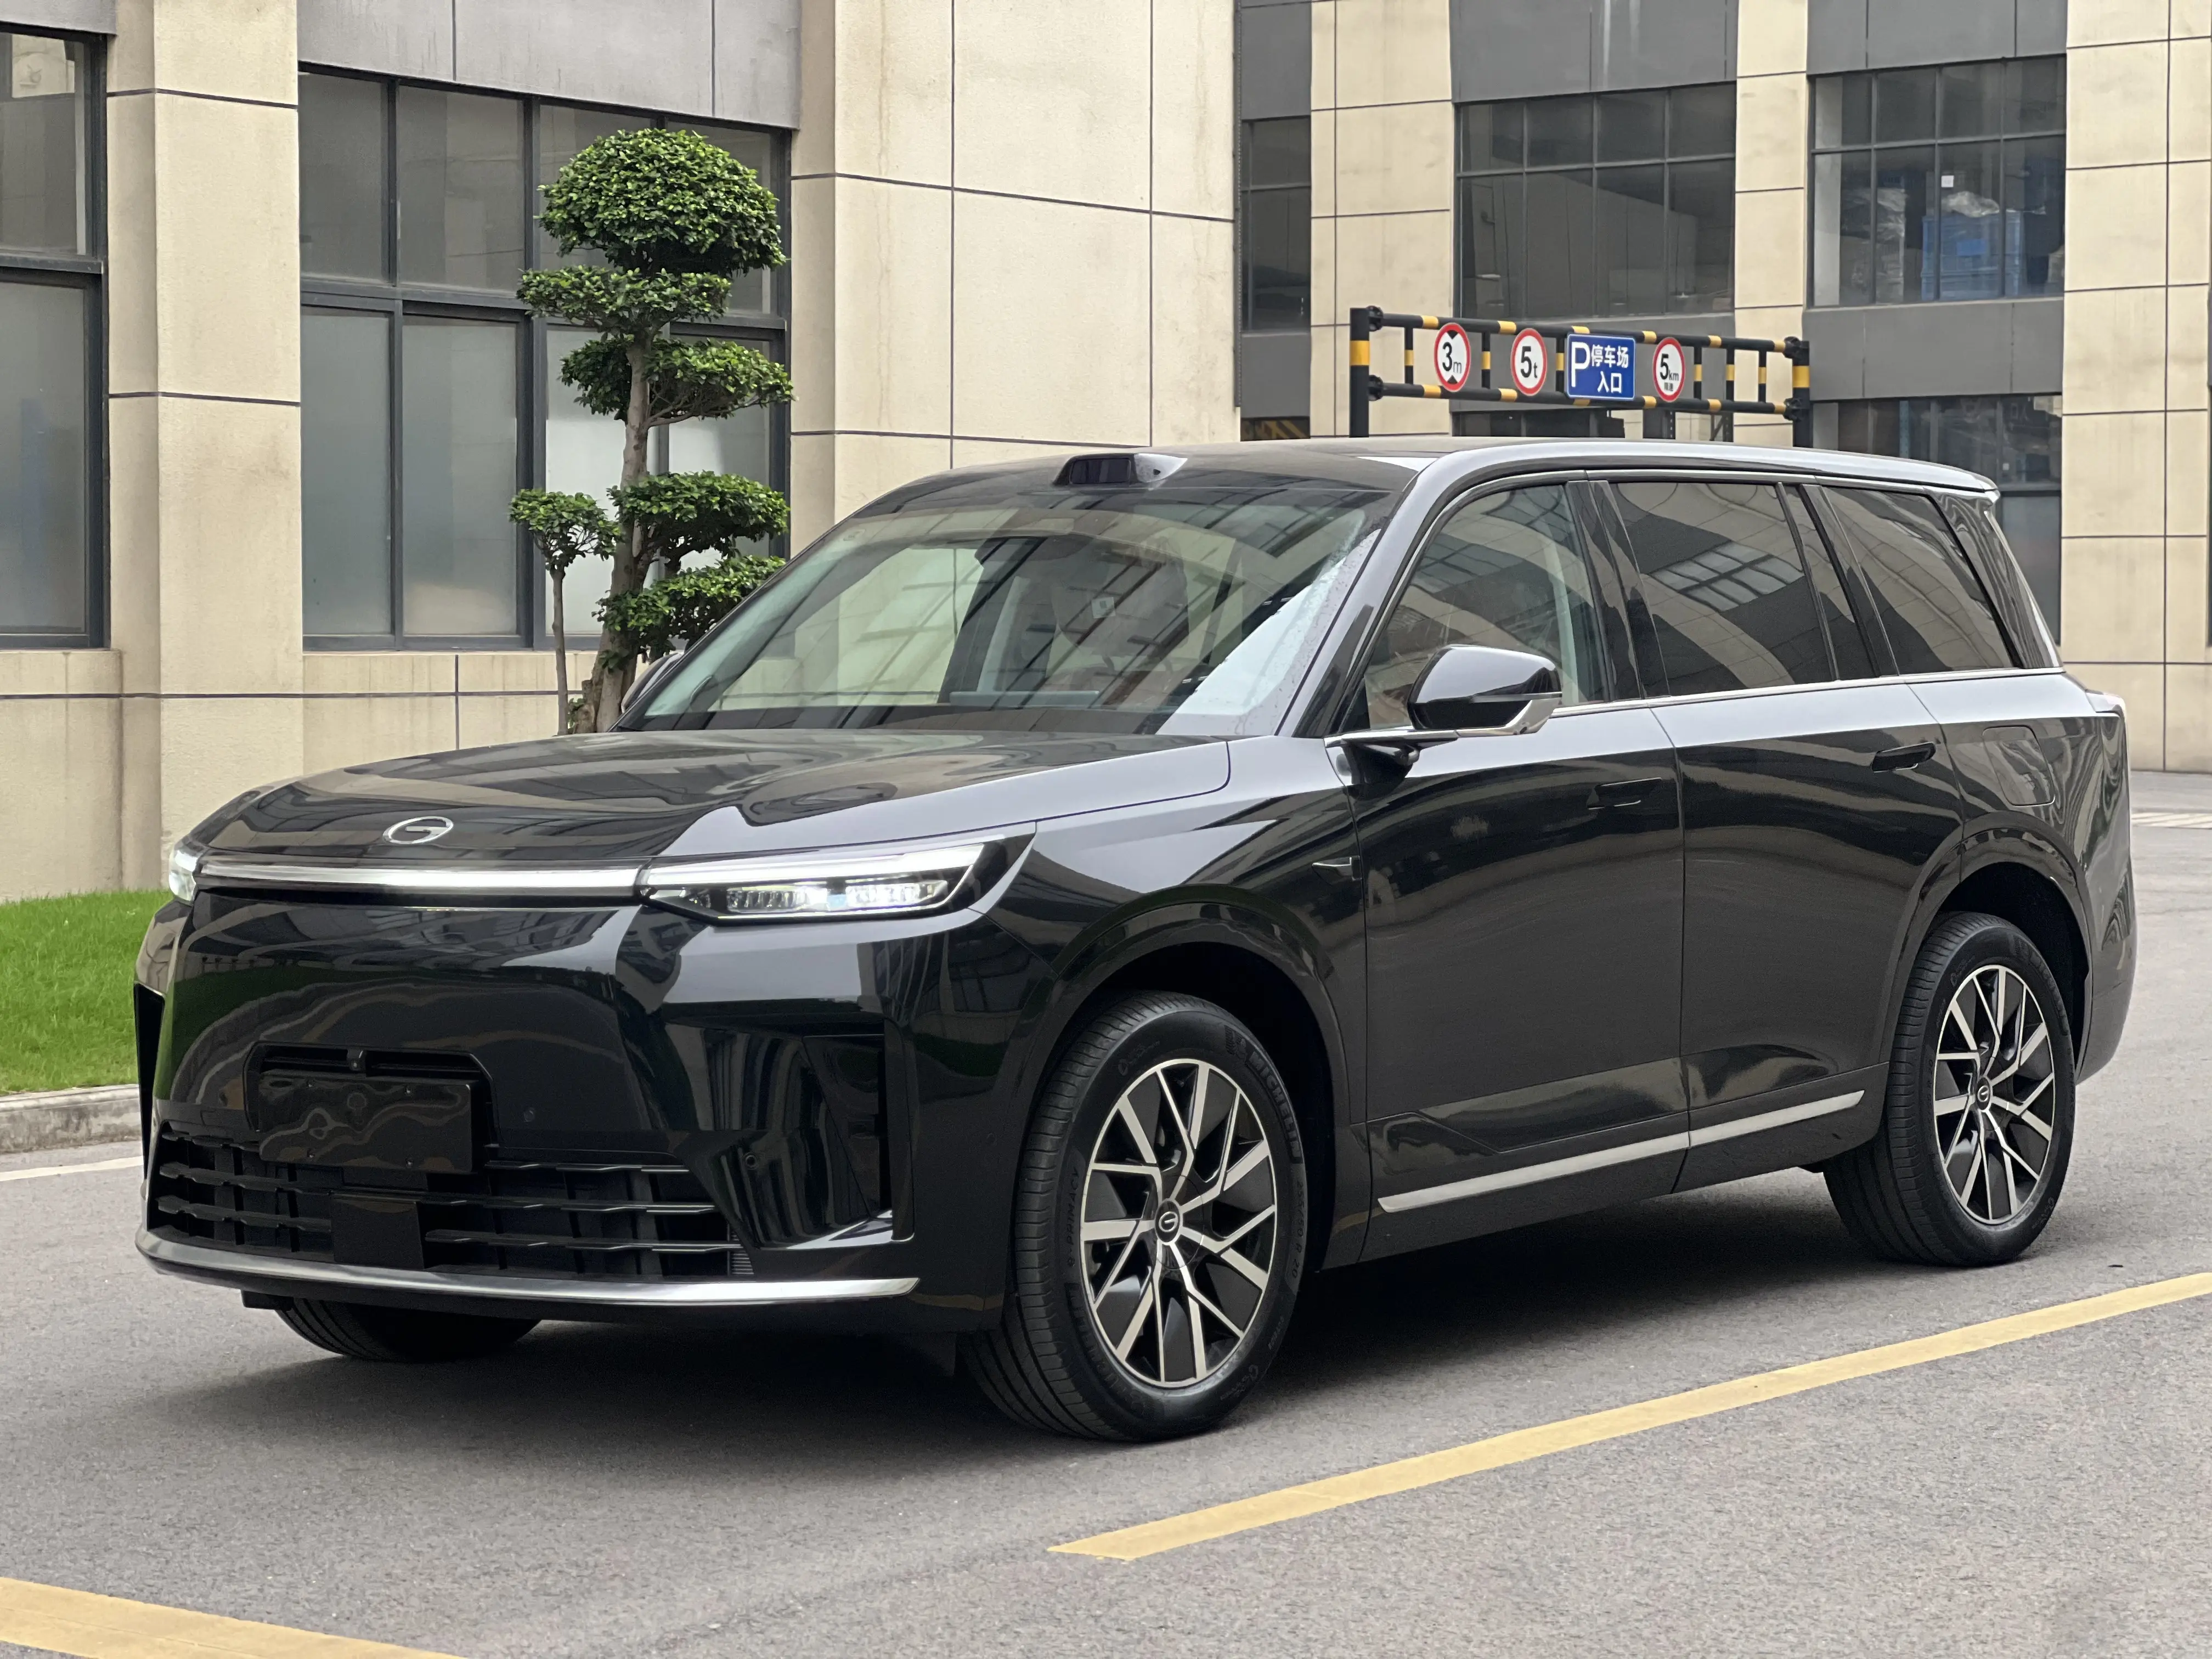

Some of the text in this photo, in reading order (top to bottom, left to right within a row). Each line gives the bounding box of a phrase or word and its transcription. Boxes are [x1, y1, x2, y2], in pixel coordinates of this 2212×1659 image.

[1521, 346, 1538, 378] 5t
[1571, 341, 1590, 387] P
[1591, 344, 1629, 369] 停车场
[1597, 371, 1622, 393] 入口
[1248, 1046, 1302, 1161] MICHELIN
[1295, 1178, 1306, 1237] 255/50
[1290, 1258, 1300, 1279] 20
